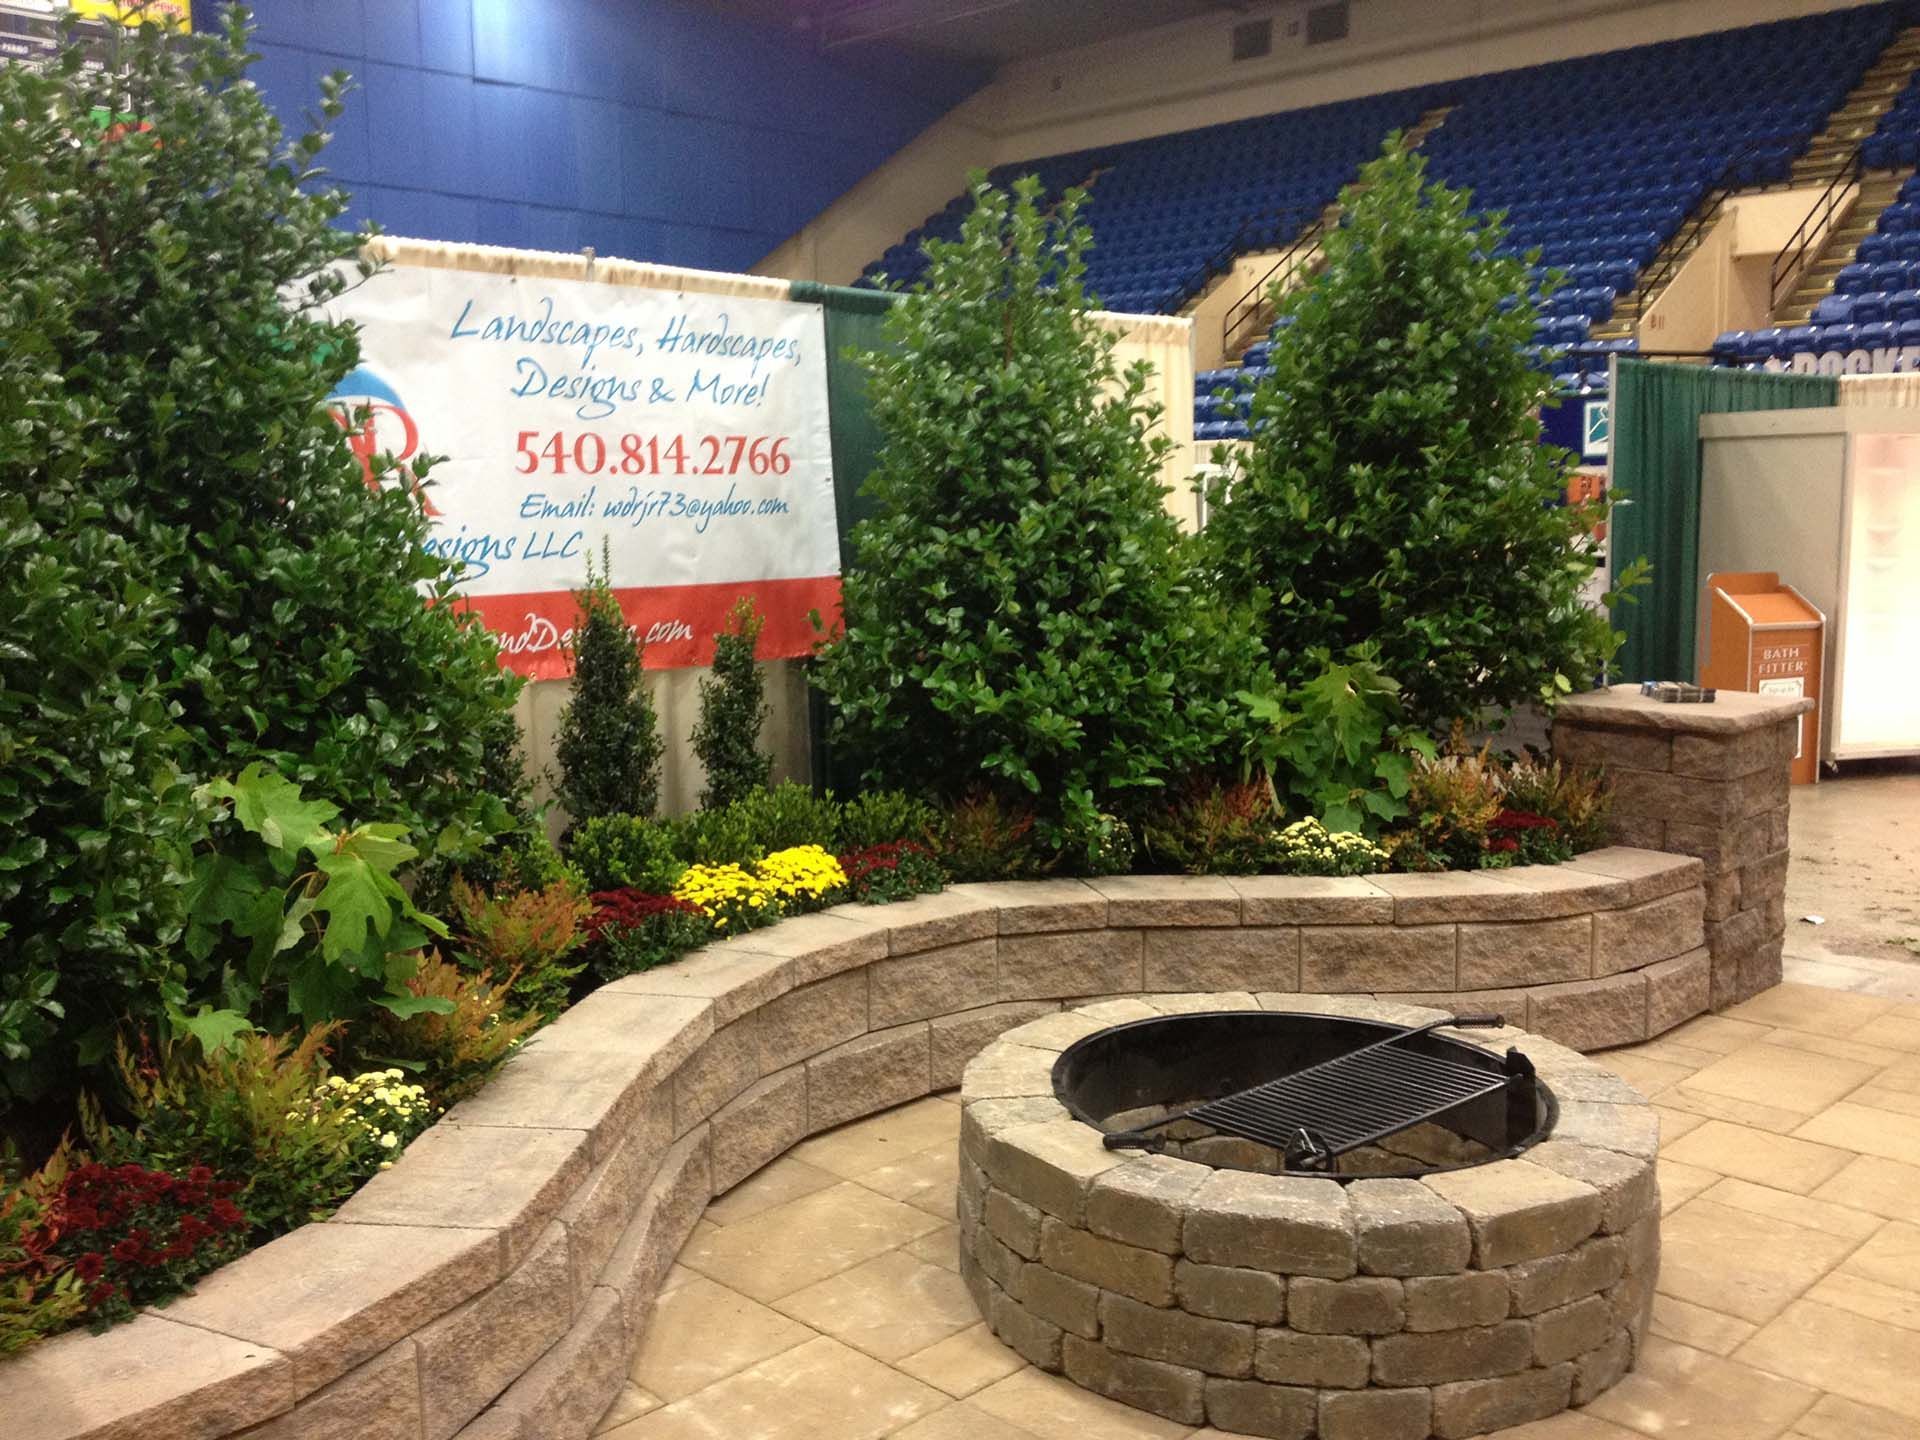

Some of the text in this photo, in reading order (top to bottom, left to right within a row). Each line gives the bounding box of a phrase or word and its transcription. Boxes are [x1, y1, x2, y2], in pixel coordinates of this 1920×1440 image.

[450, 296, 802, 377] Landscapes, Hardscapes,
[510, 356, 770, 419] Designs & More!
[514, 430, 791, 476] 540.814.2766
[519, 482, 790, 534] Email: wdrjr73@yahoo.com
[422, 525, 584, 581] esigns LLC
[1763, 647, 1799, 660] BATH
